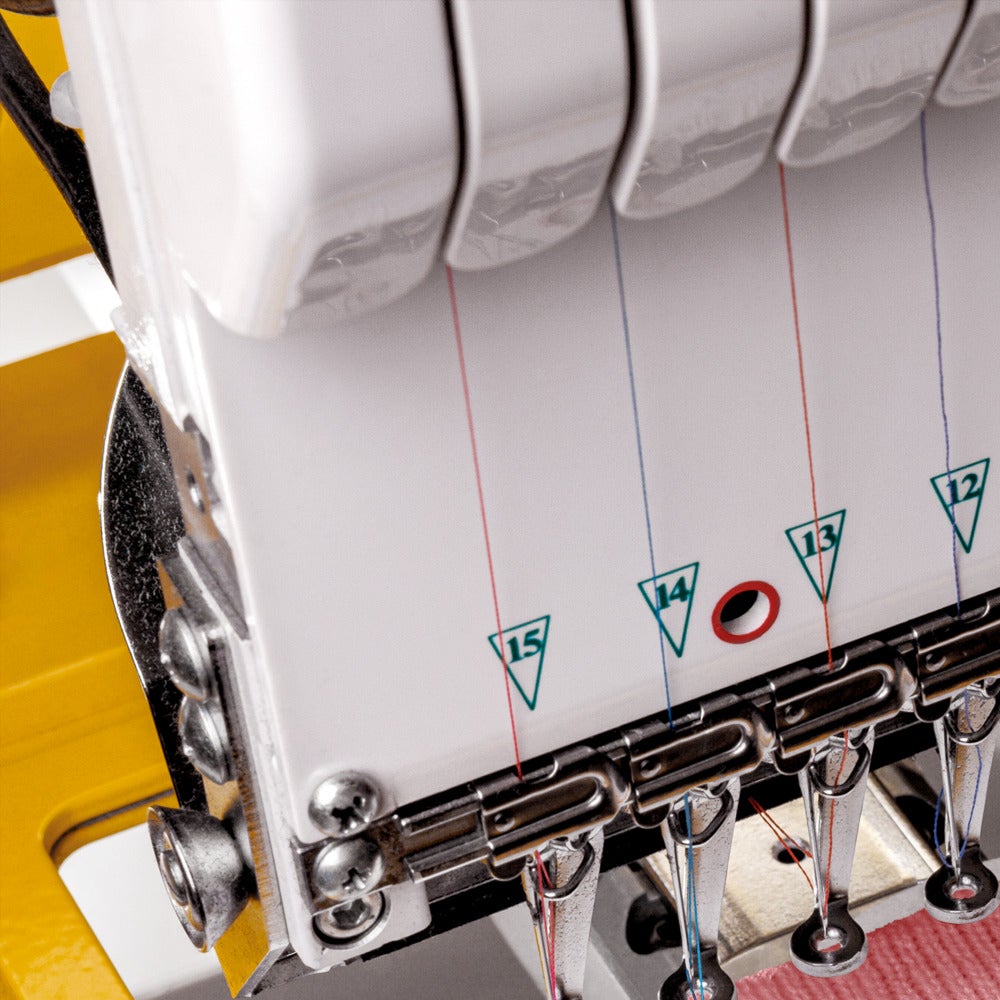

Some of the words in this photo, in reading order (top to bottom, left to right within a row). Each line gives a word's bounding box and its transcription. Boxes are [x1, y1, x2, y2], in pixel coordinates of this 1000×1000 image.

[946, 472, 982, 506] 12
[801, 523, 838, 558] 13
[654, 576, 690, 612] 14
[506, 628, 544, 663] 15
